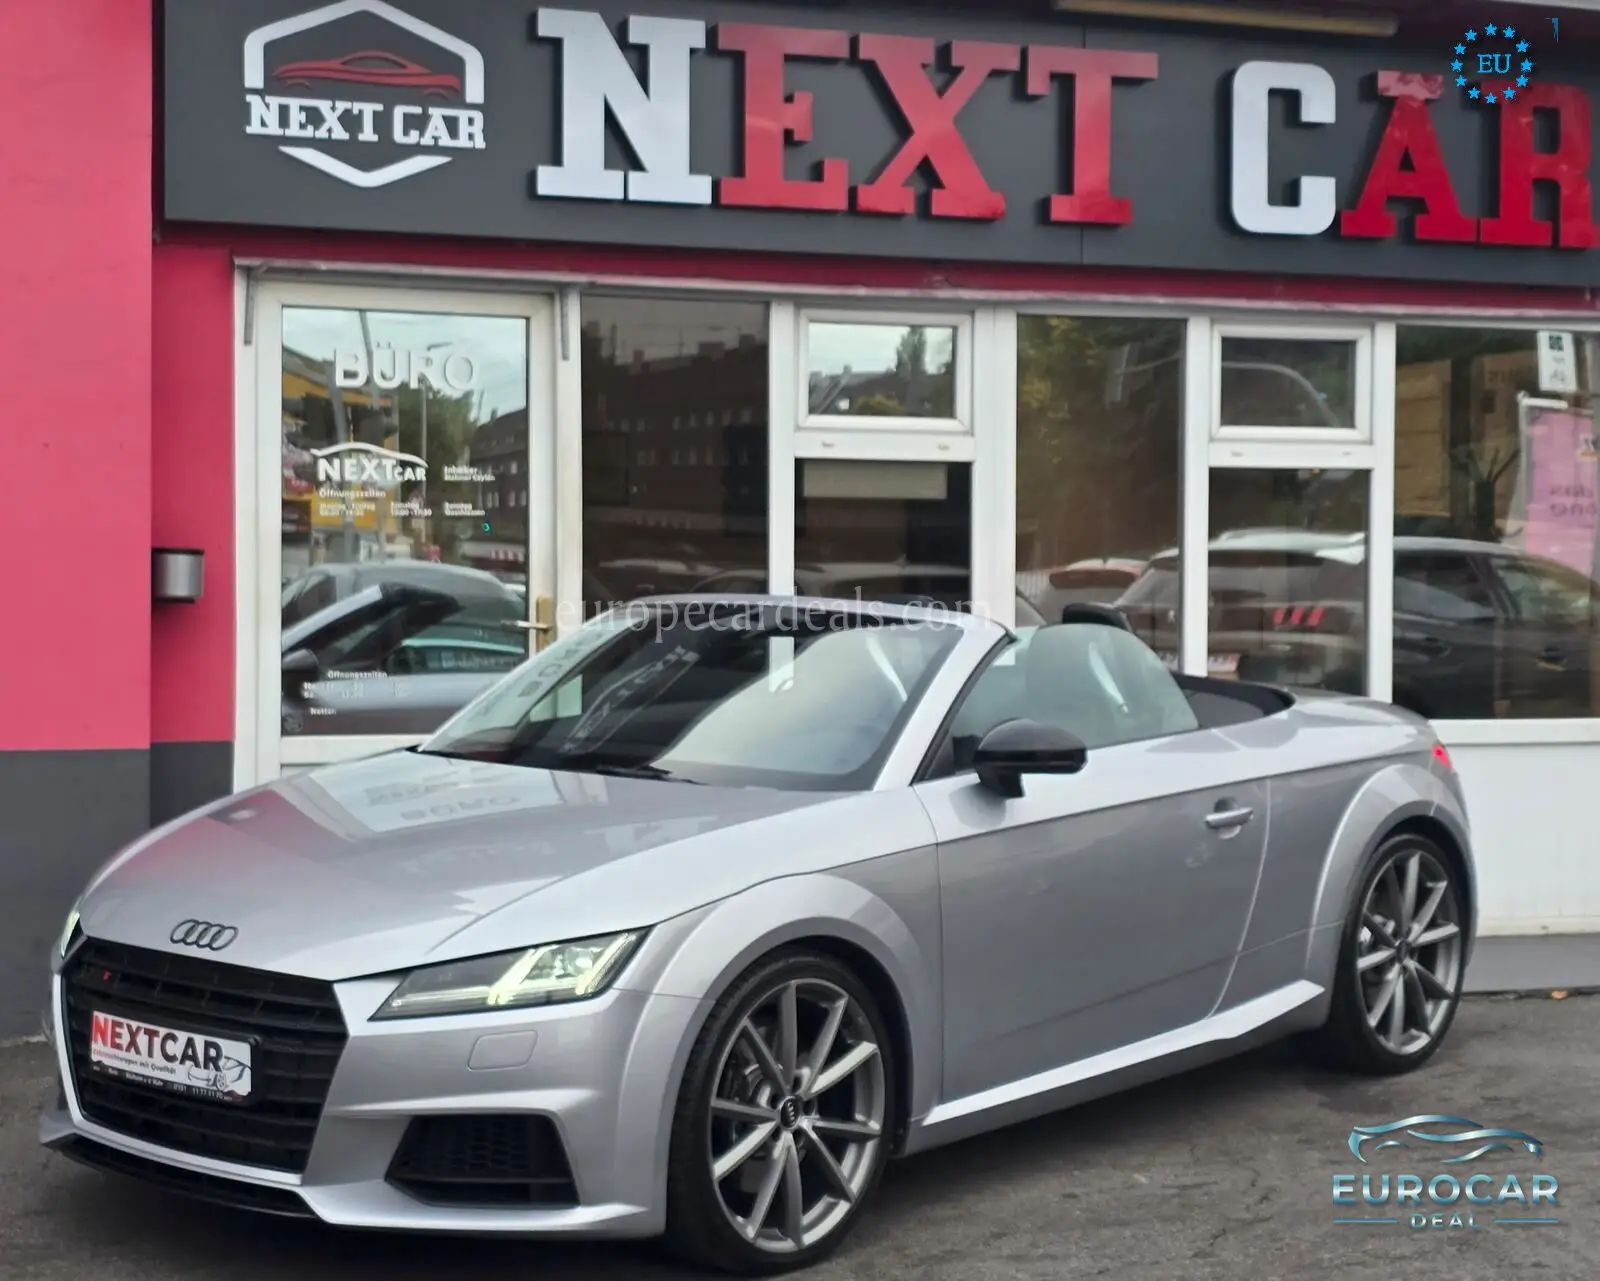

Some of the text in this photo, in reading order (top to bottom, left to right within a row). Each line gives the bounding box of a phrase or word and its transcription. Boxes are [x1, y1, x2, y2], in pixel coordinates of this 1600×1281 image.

[244, 94, 487, 149] NEXT CAR
[536, 7, 1598, 249] NEXT CAR
[335, 341, 478, 395] BÜRO
[92, 1014, 225, 1072] NEXTCAR
